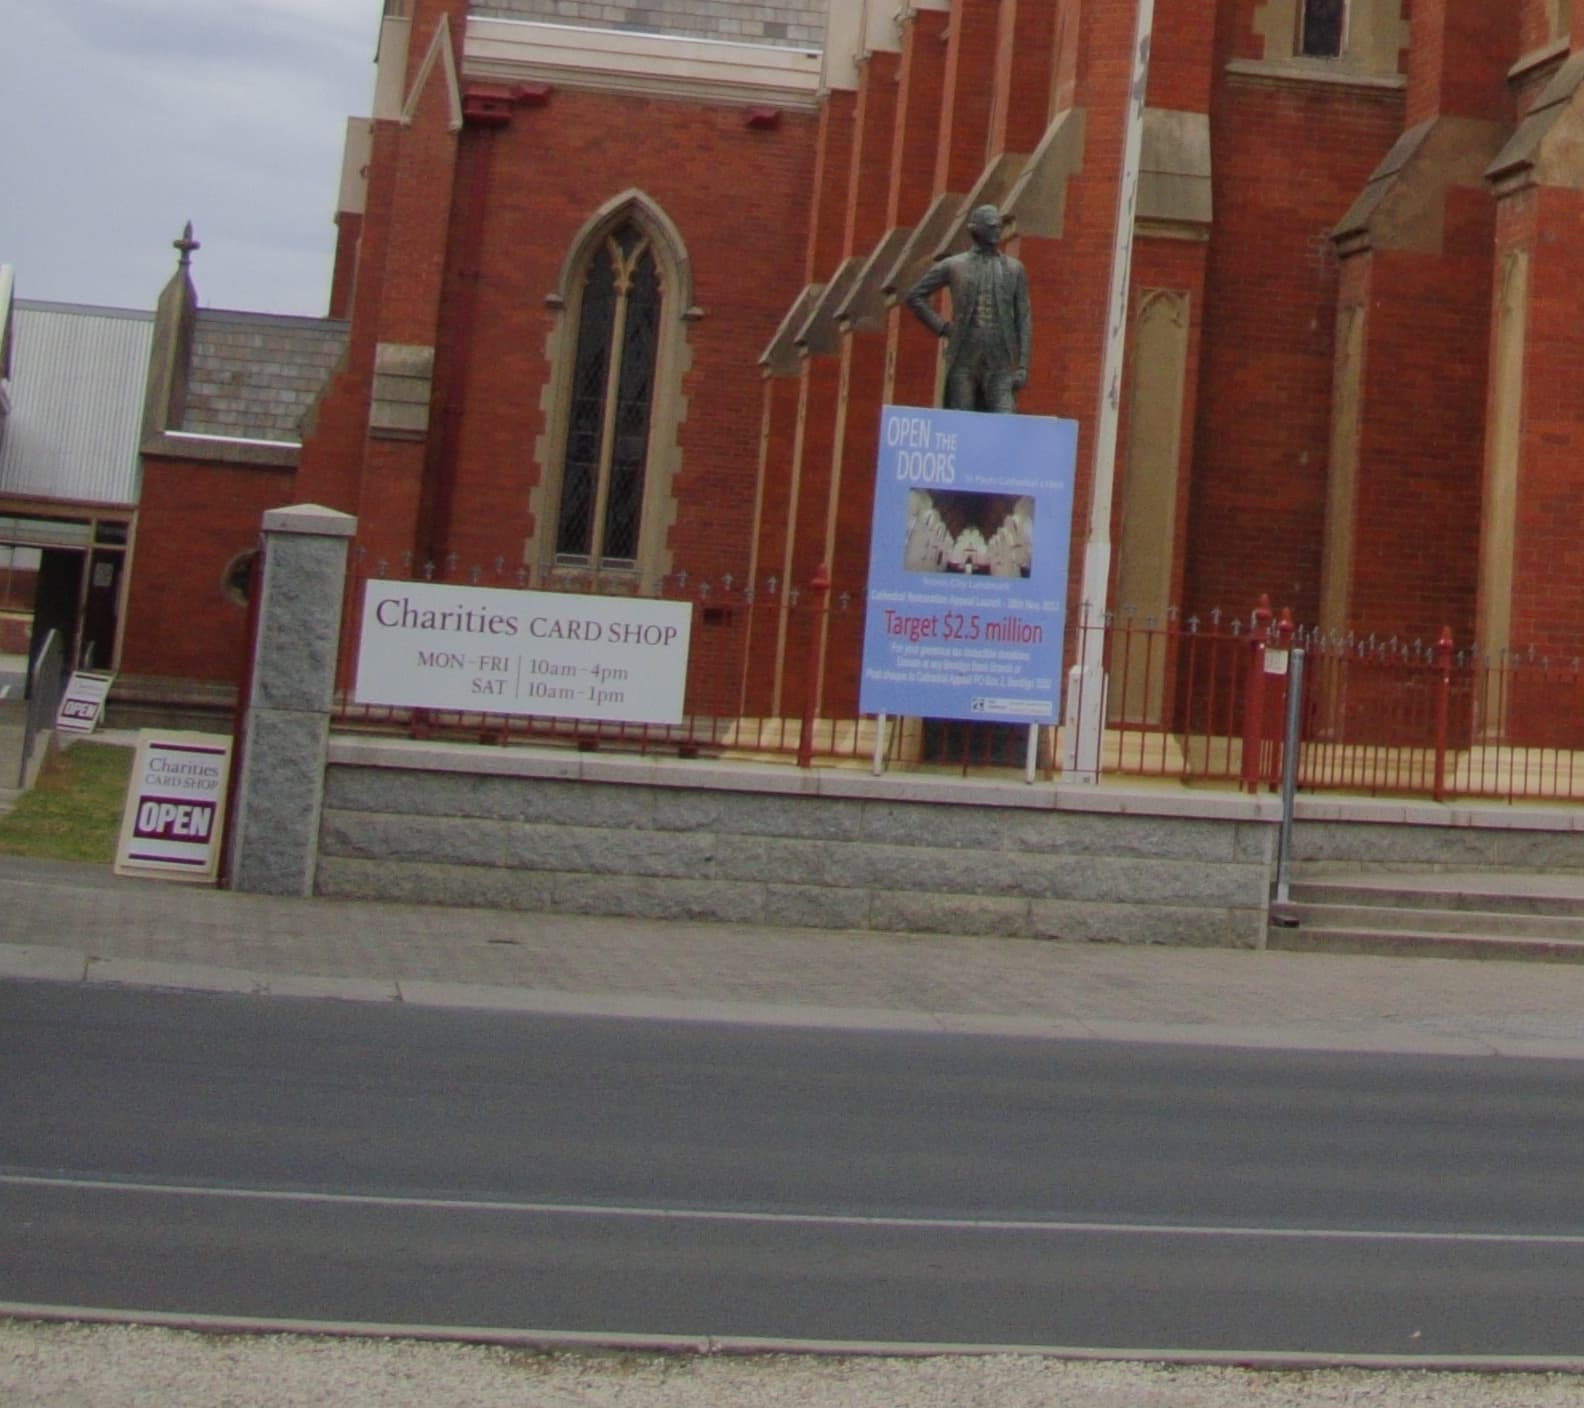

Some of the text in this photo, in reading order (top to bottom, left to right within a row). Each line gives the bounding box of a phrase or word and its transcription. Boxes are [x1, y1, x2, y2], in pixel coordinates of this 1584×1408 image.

[887, 415, 958, 451] OPEN THE
[897, 450, 955, 482] DOORS
[376, 598, 678, 646] Charities CARD SHOP
[884, 610, 1043, 644] Target $2.5 million
[471, 678, 508, 695] SAT
[64, 701, 98, 718] OPEN
[144, 774, 219, 791] CARD SHOP
[149, 757, 219, 777] Charities
[138, 800, 212, 838] OPEN
